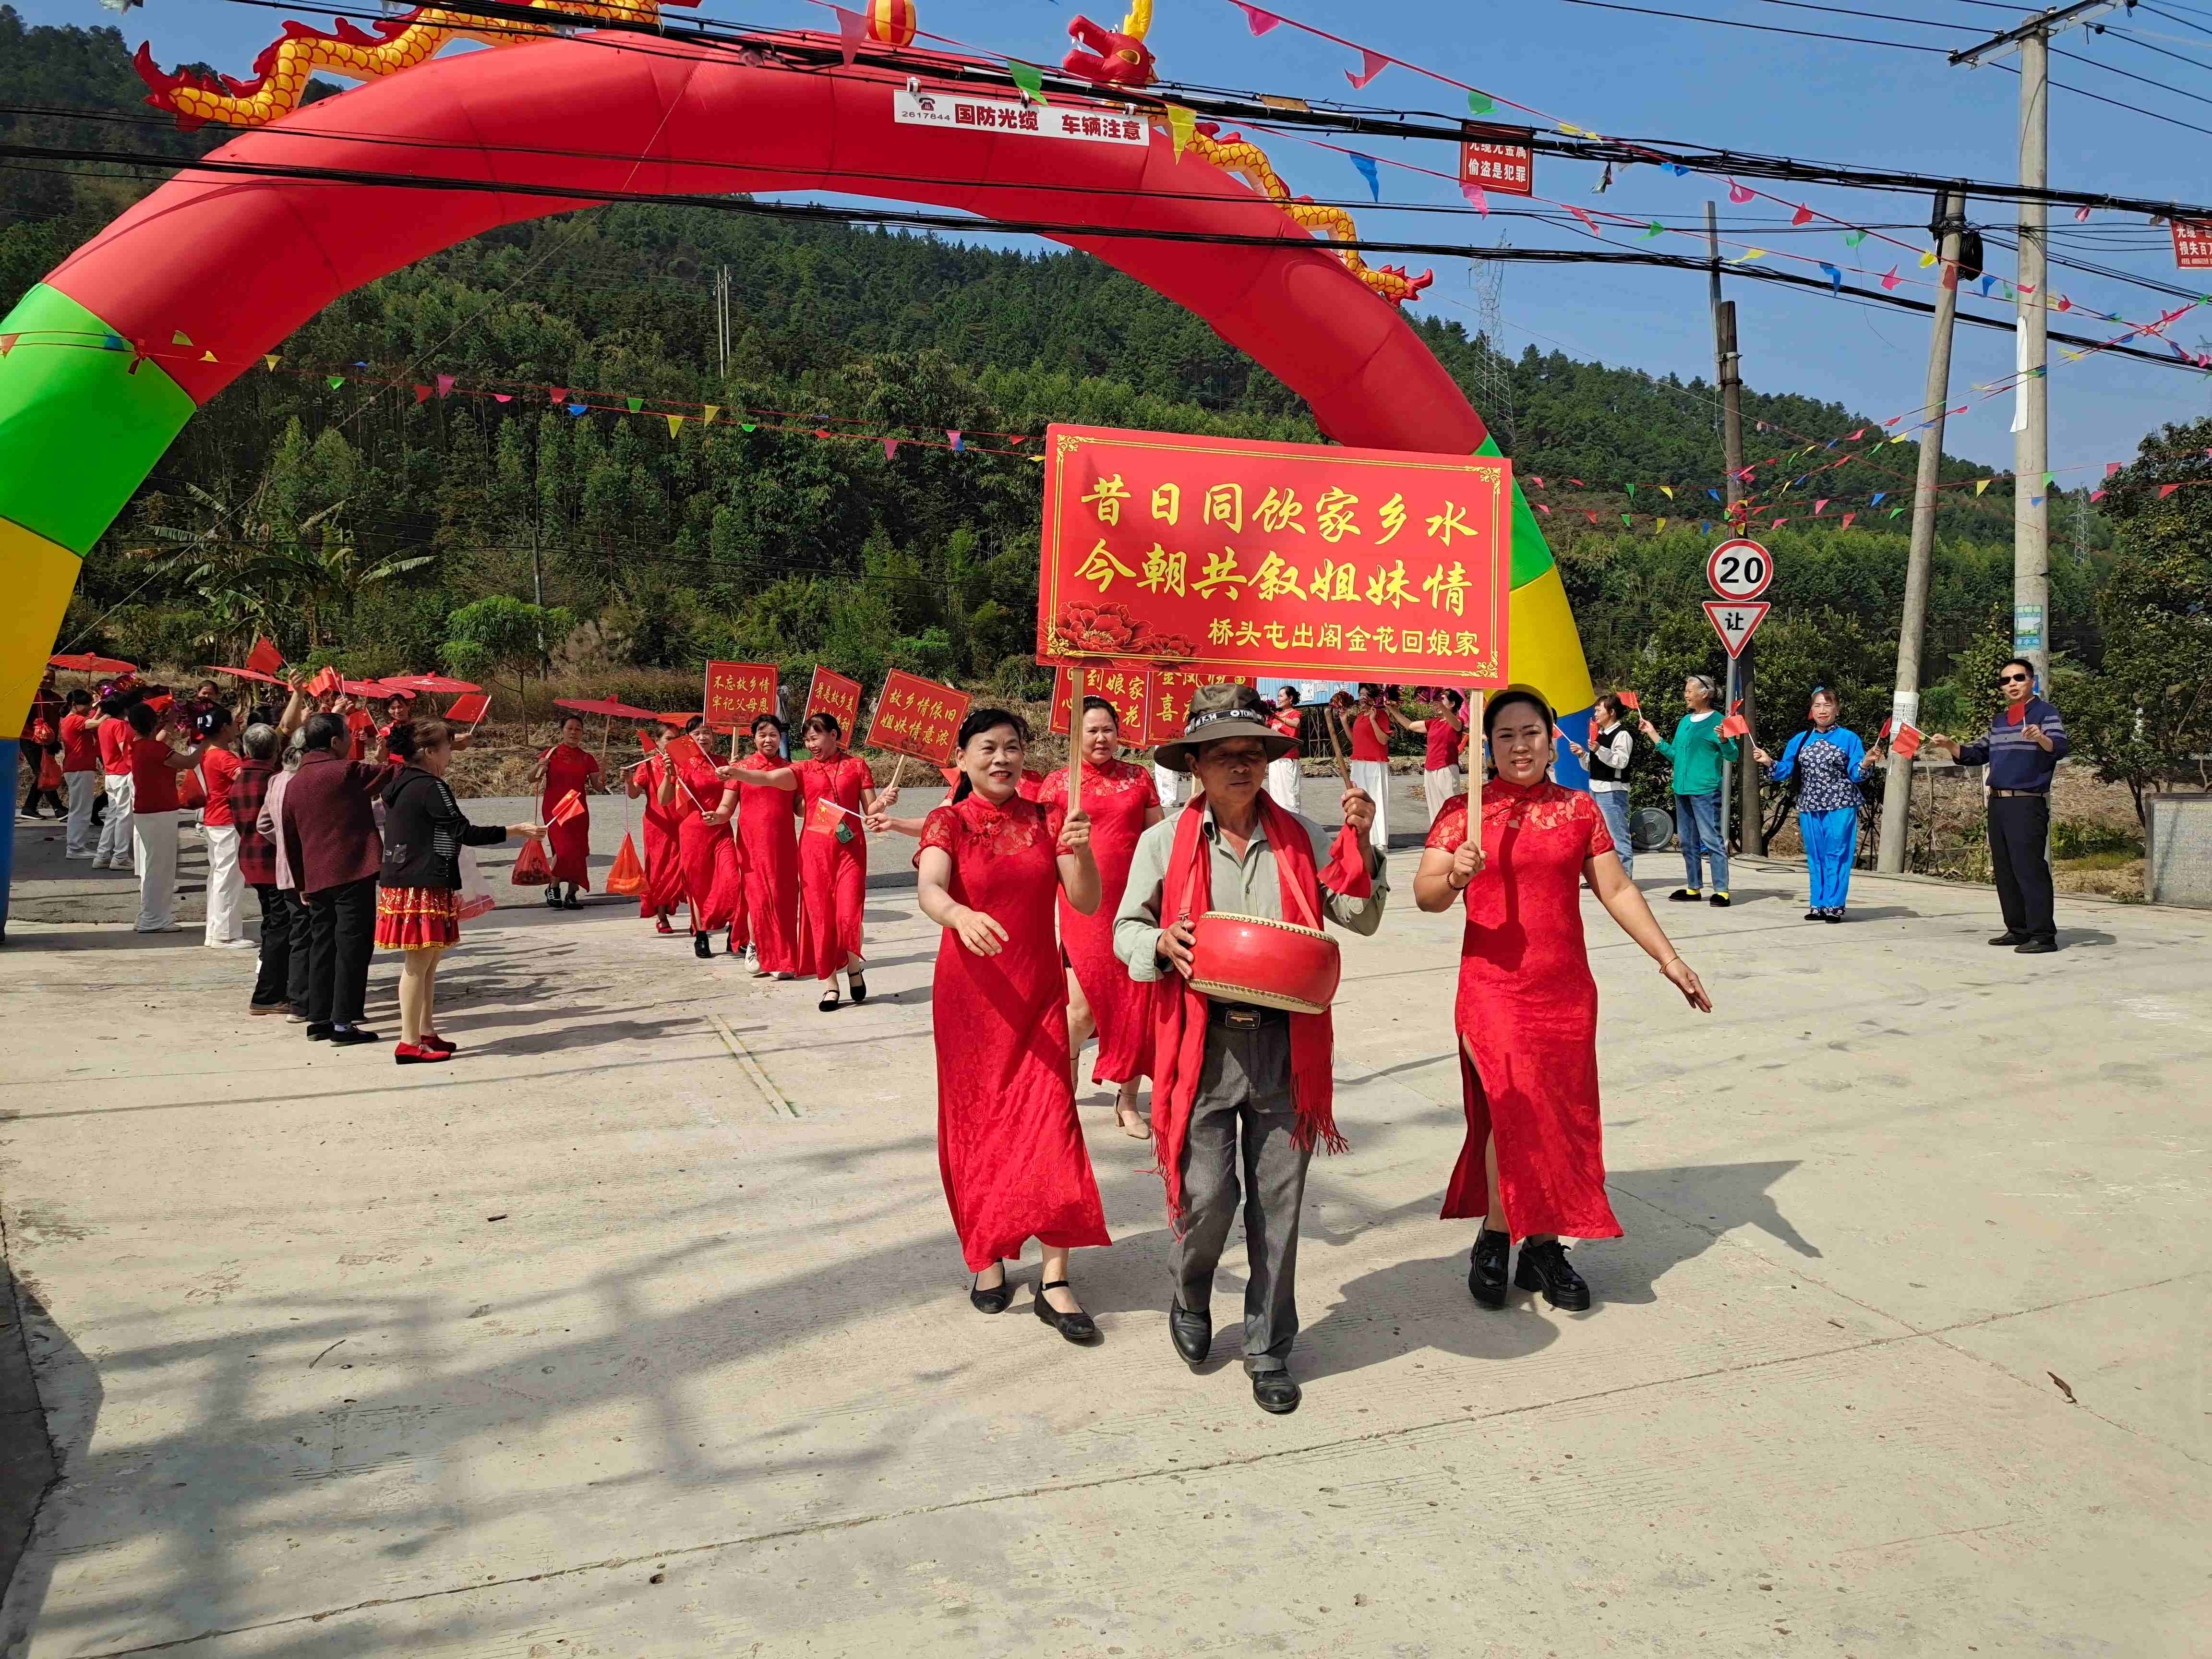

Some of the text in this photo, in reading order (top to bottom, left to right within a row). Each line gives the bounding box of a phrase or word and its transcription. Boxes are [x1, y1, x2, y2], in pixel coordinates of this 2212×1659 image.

[955, 104, 1141, 140] 国防光缆 车辆注意
[1468, 158, 1526, 182] 偷盗是犯罪
[1081, 474, 1479, 547] 昔日同饮家乡水
[1074, 539, 1473, 616] 今朝共叙姐妹情
[1720, 557, 1763, 583] 20
[1208, 617, 1479, 656] 桥头屯出阁金花回娘家
[1725, 613, 1744, 630] 让
[713, 674, 770, 694] 不忘故乡情
[712, 694, 769, 714] 牢记父母恩
[890, 688, 957, 722] 故乡情依旧
[880, 712, 949, 746] 姐妹情意浓
